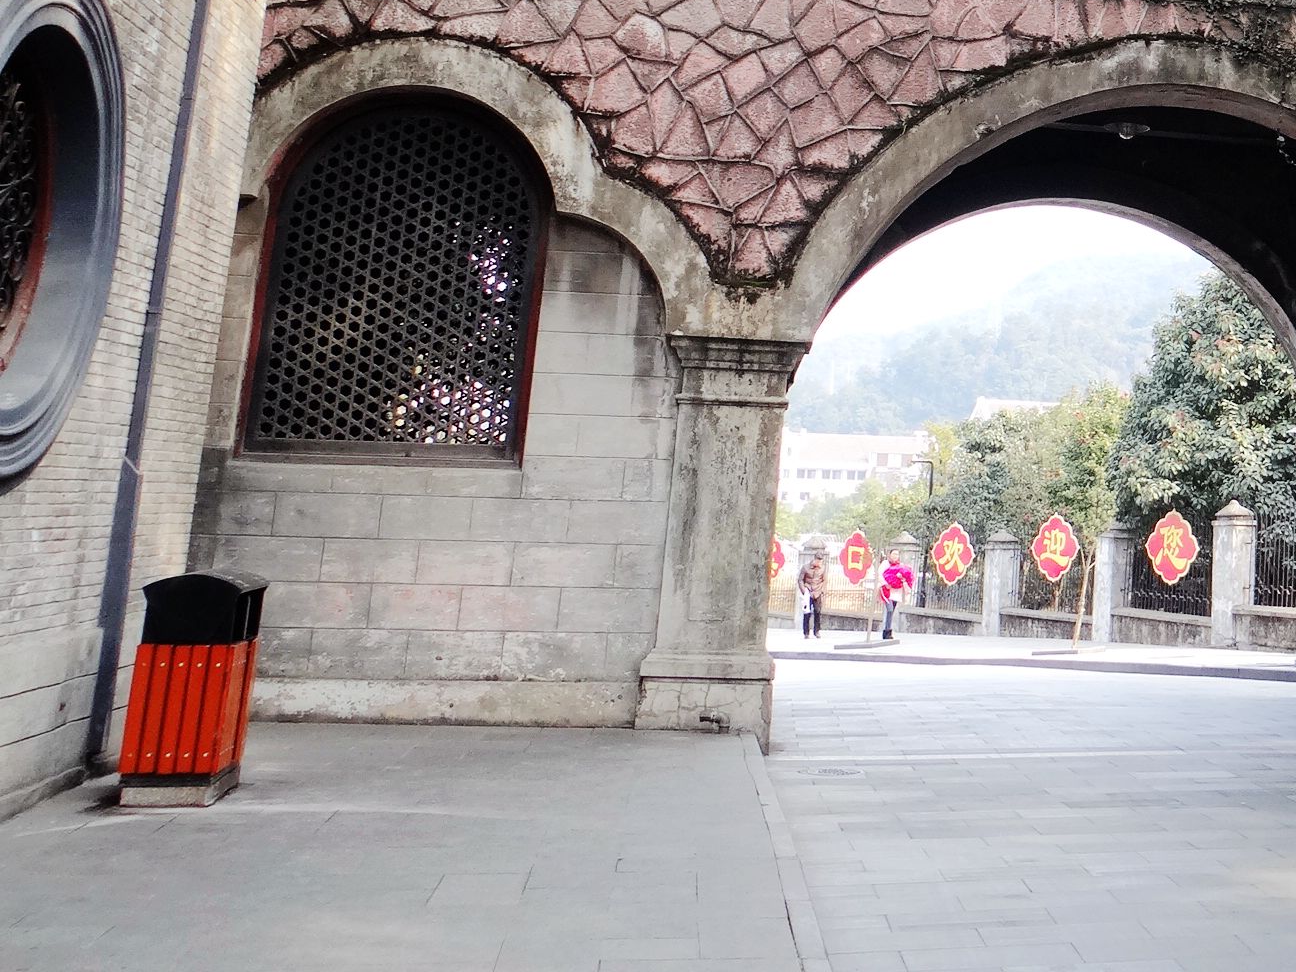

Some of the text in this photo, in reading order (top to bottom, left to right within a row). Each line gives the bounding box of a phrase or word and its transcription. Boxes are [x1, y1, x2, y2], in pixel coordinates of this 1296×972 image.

[847, 524, 1188, 573] 口 欢 迎 您
